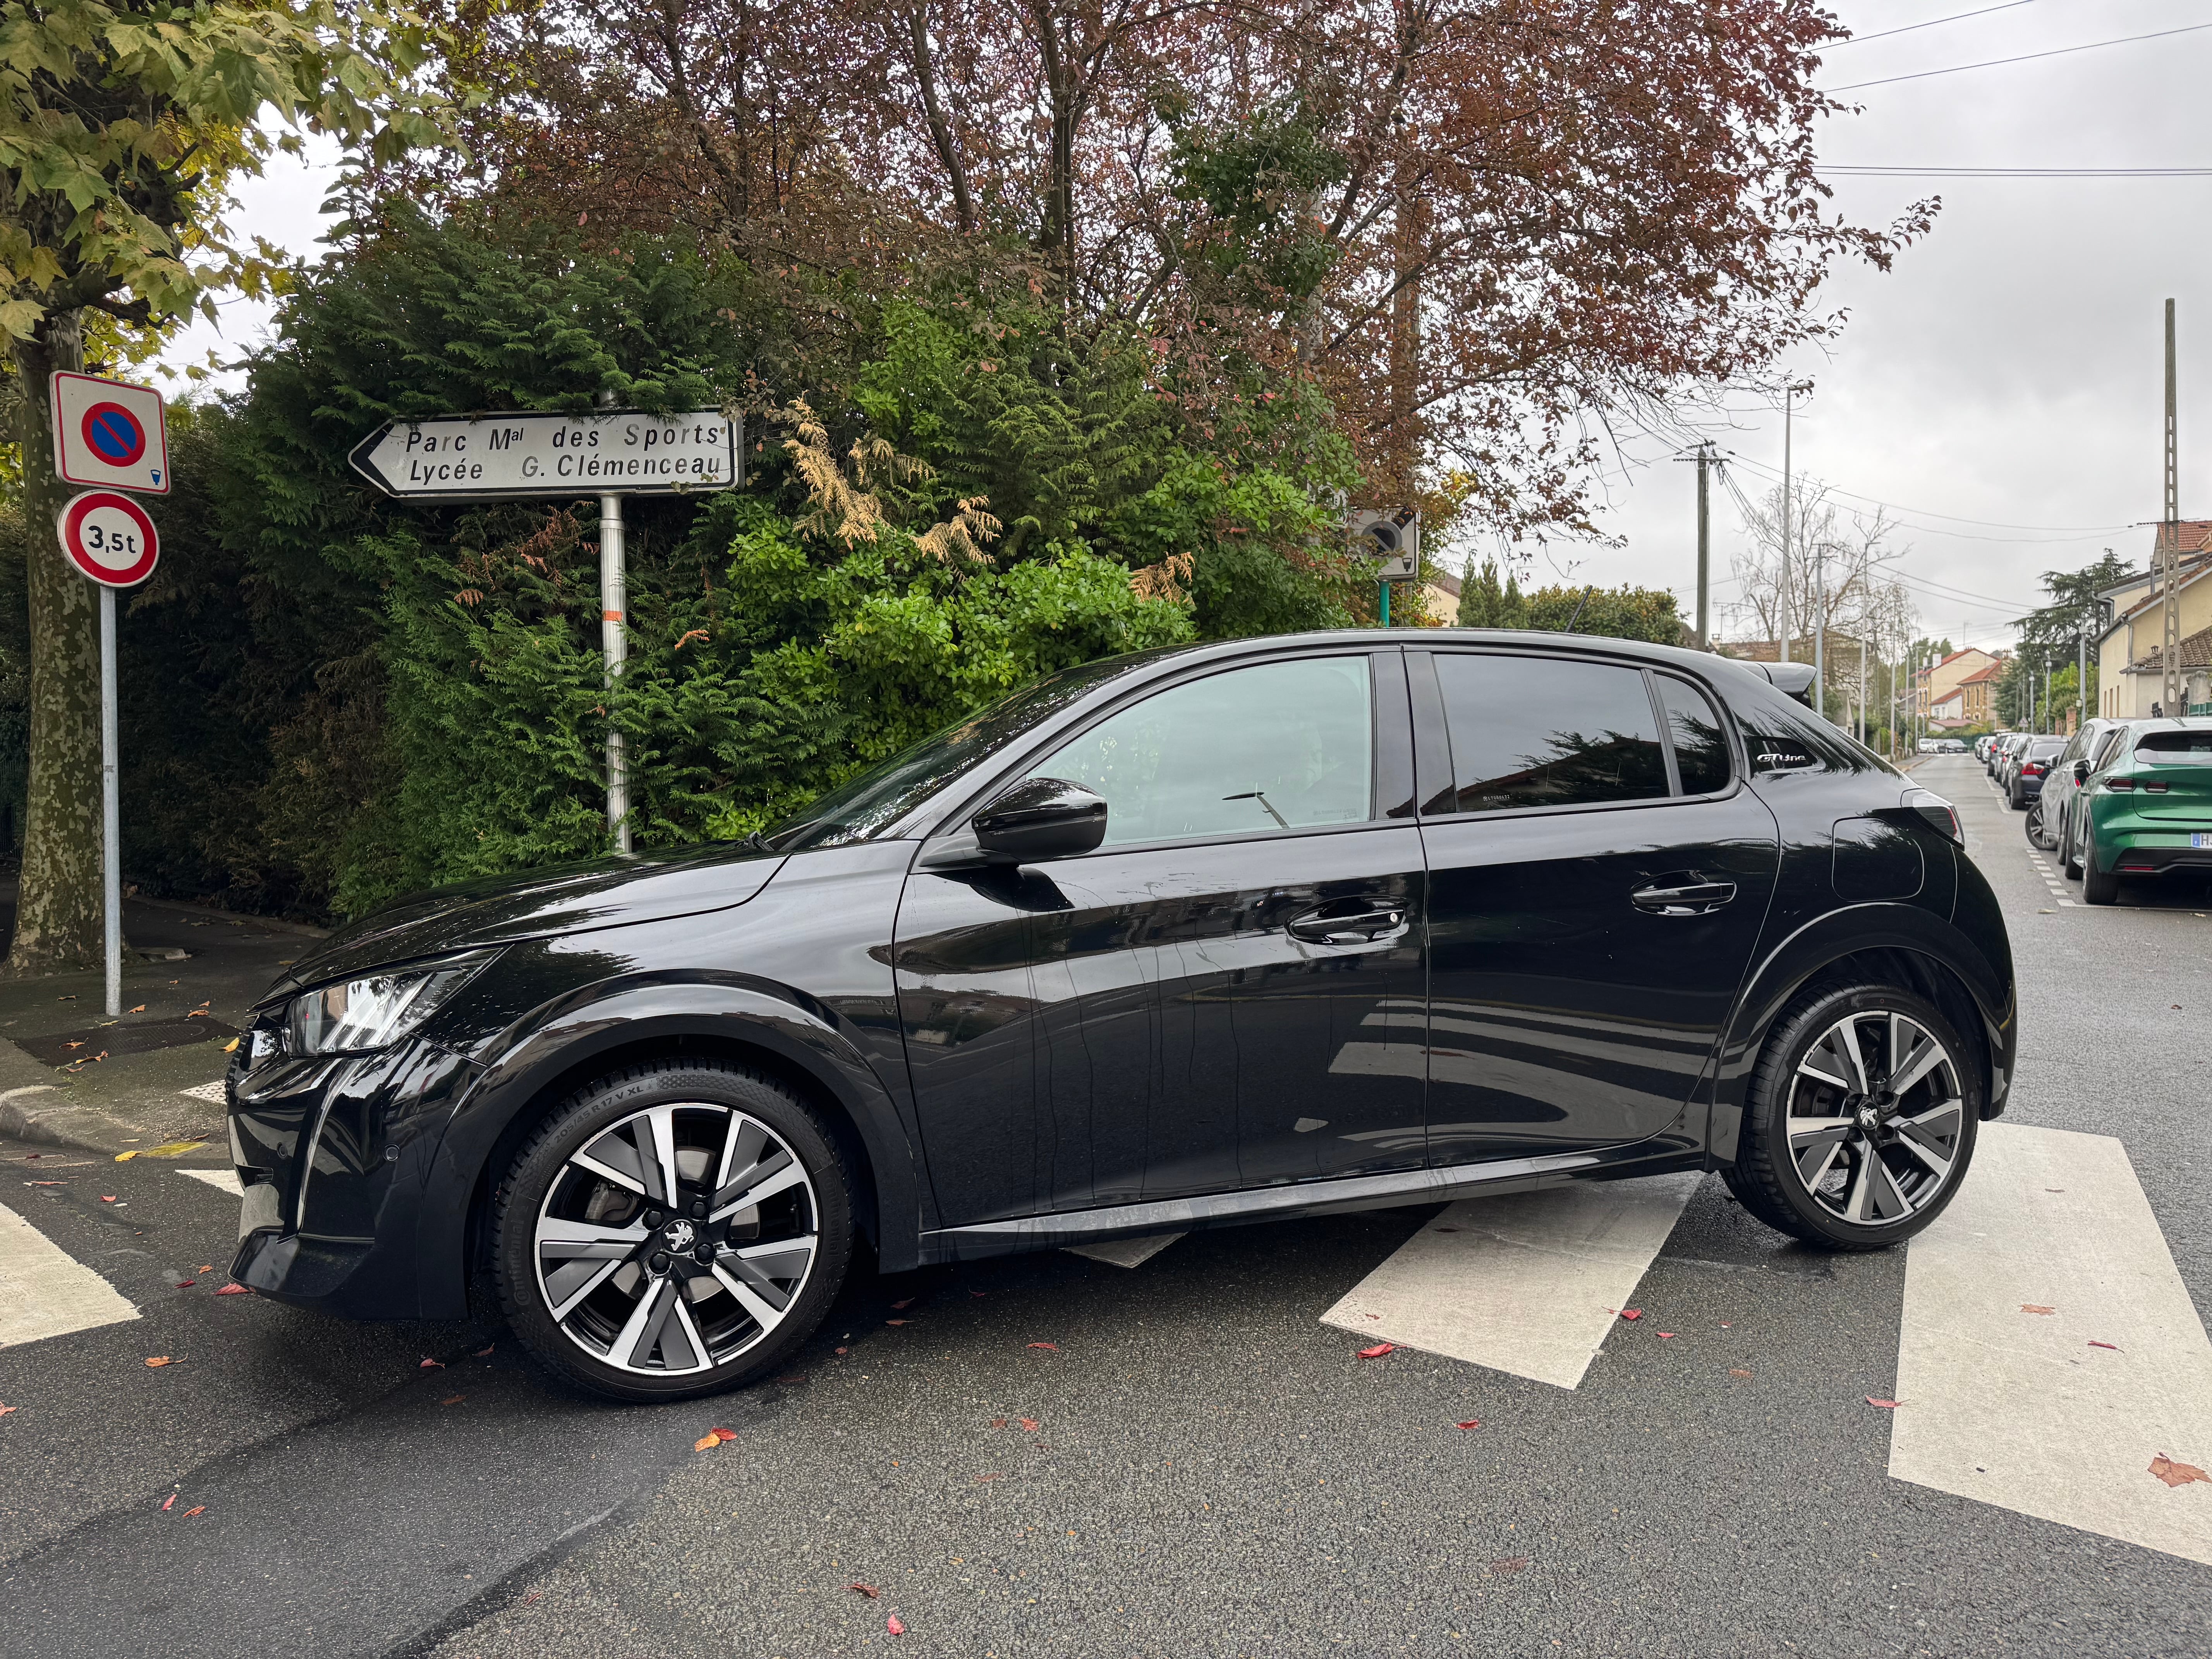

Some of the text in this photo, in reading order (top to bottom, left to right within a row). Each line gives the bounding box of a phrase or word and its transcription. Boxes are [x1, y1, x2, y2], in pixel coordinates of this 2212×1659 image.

[406, 424, 718, 452] Parc Mal des Sports
[410, 453, 720, 485] Lycée G. Clémenceau
[88, 525, 136, 554] 3,5t
[554, 1110, 591, 1144] 205/45
[615, 1091, 624, 1100] V
[627, 1085, 644, 1096] XL
